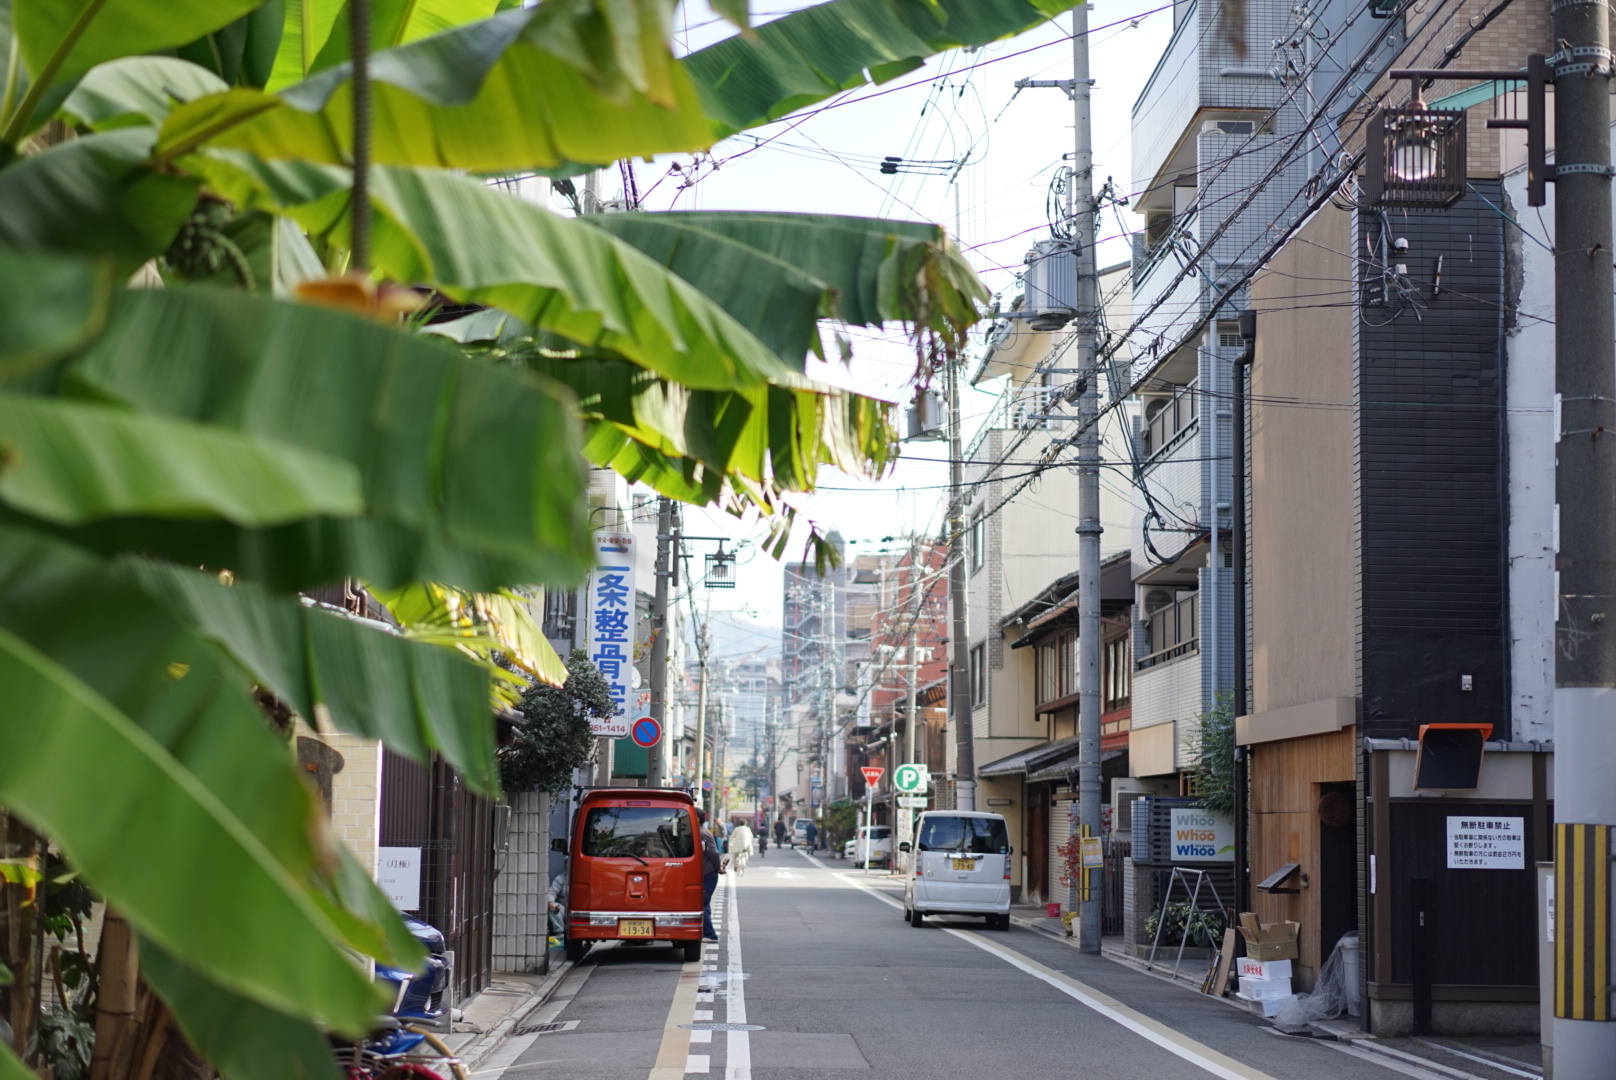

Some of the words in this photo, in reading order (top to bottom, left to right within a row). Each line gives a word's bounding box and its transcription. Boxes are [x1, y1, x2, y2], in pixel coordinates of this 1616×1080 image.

[903, 770, 917, 788] P
[1176, 813, 1215, 826] Whoo
[1461, 821, 1511, 830] 無断駐車禁止
[1176, 829, 1215, 841] Whoo
[1176, 844, 1215, 856] Whoo
